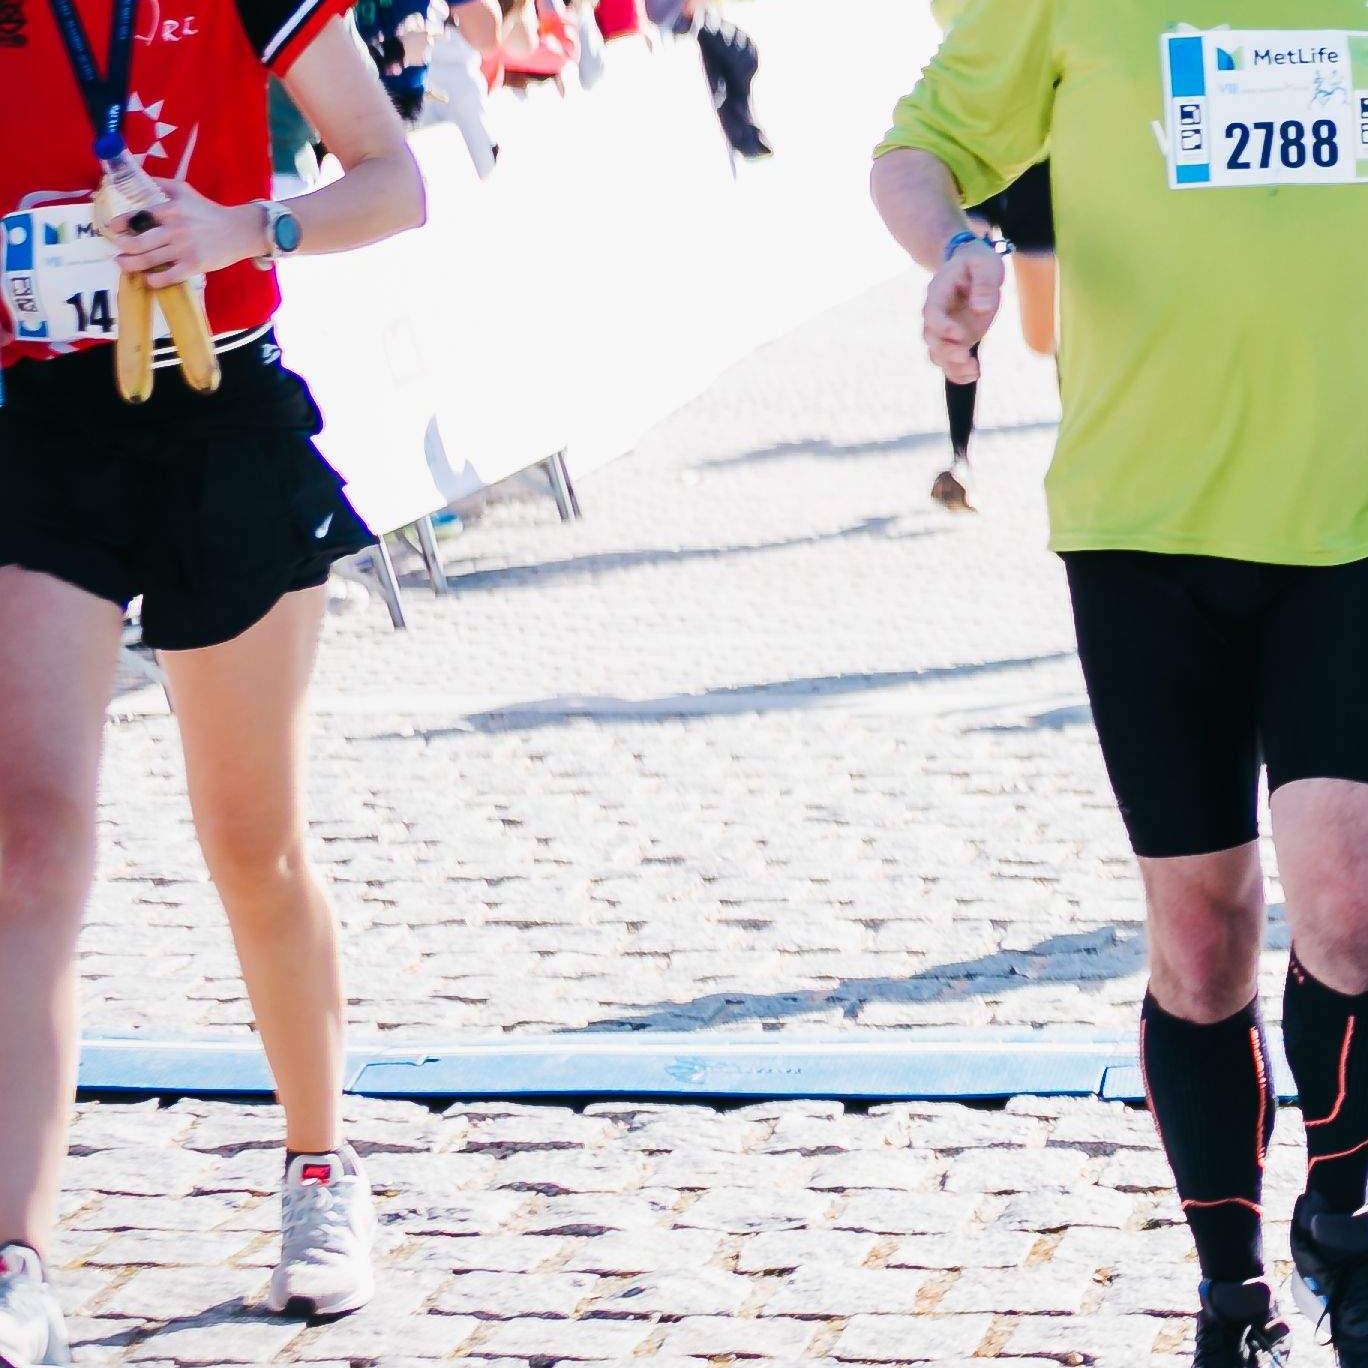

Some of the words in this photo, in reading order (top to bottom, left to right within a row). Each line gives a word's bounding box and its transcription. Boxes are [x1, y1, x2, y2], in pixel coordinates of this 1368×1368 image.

[1253, 47, 1339, 65] MetLife
[1225, 119, 1339, 170] 2788
[65, 289, 119, 333] 14
